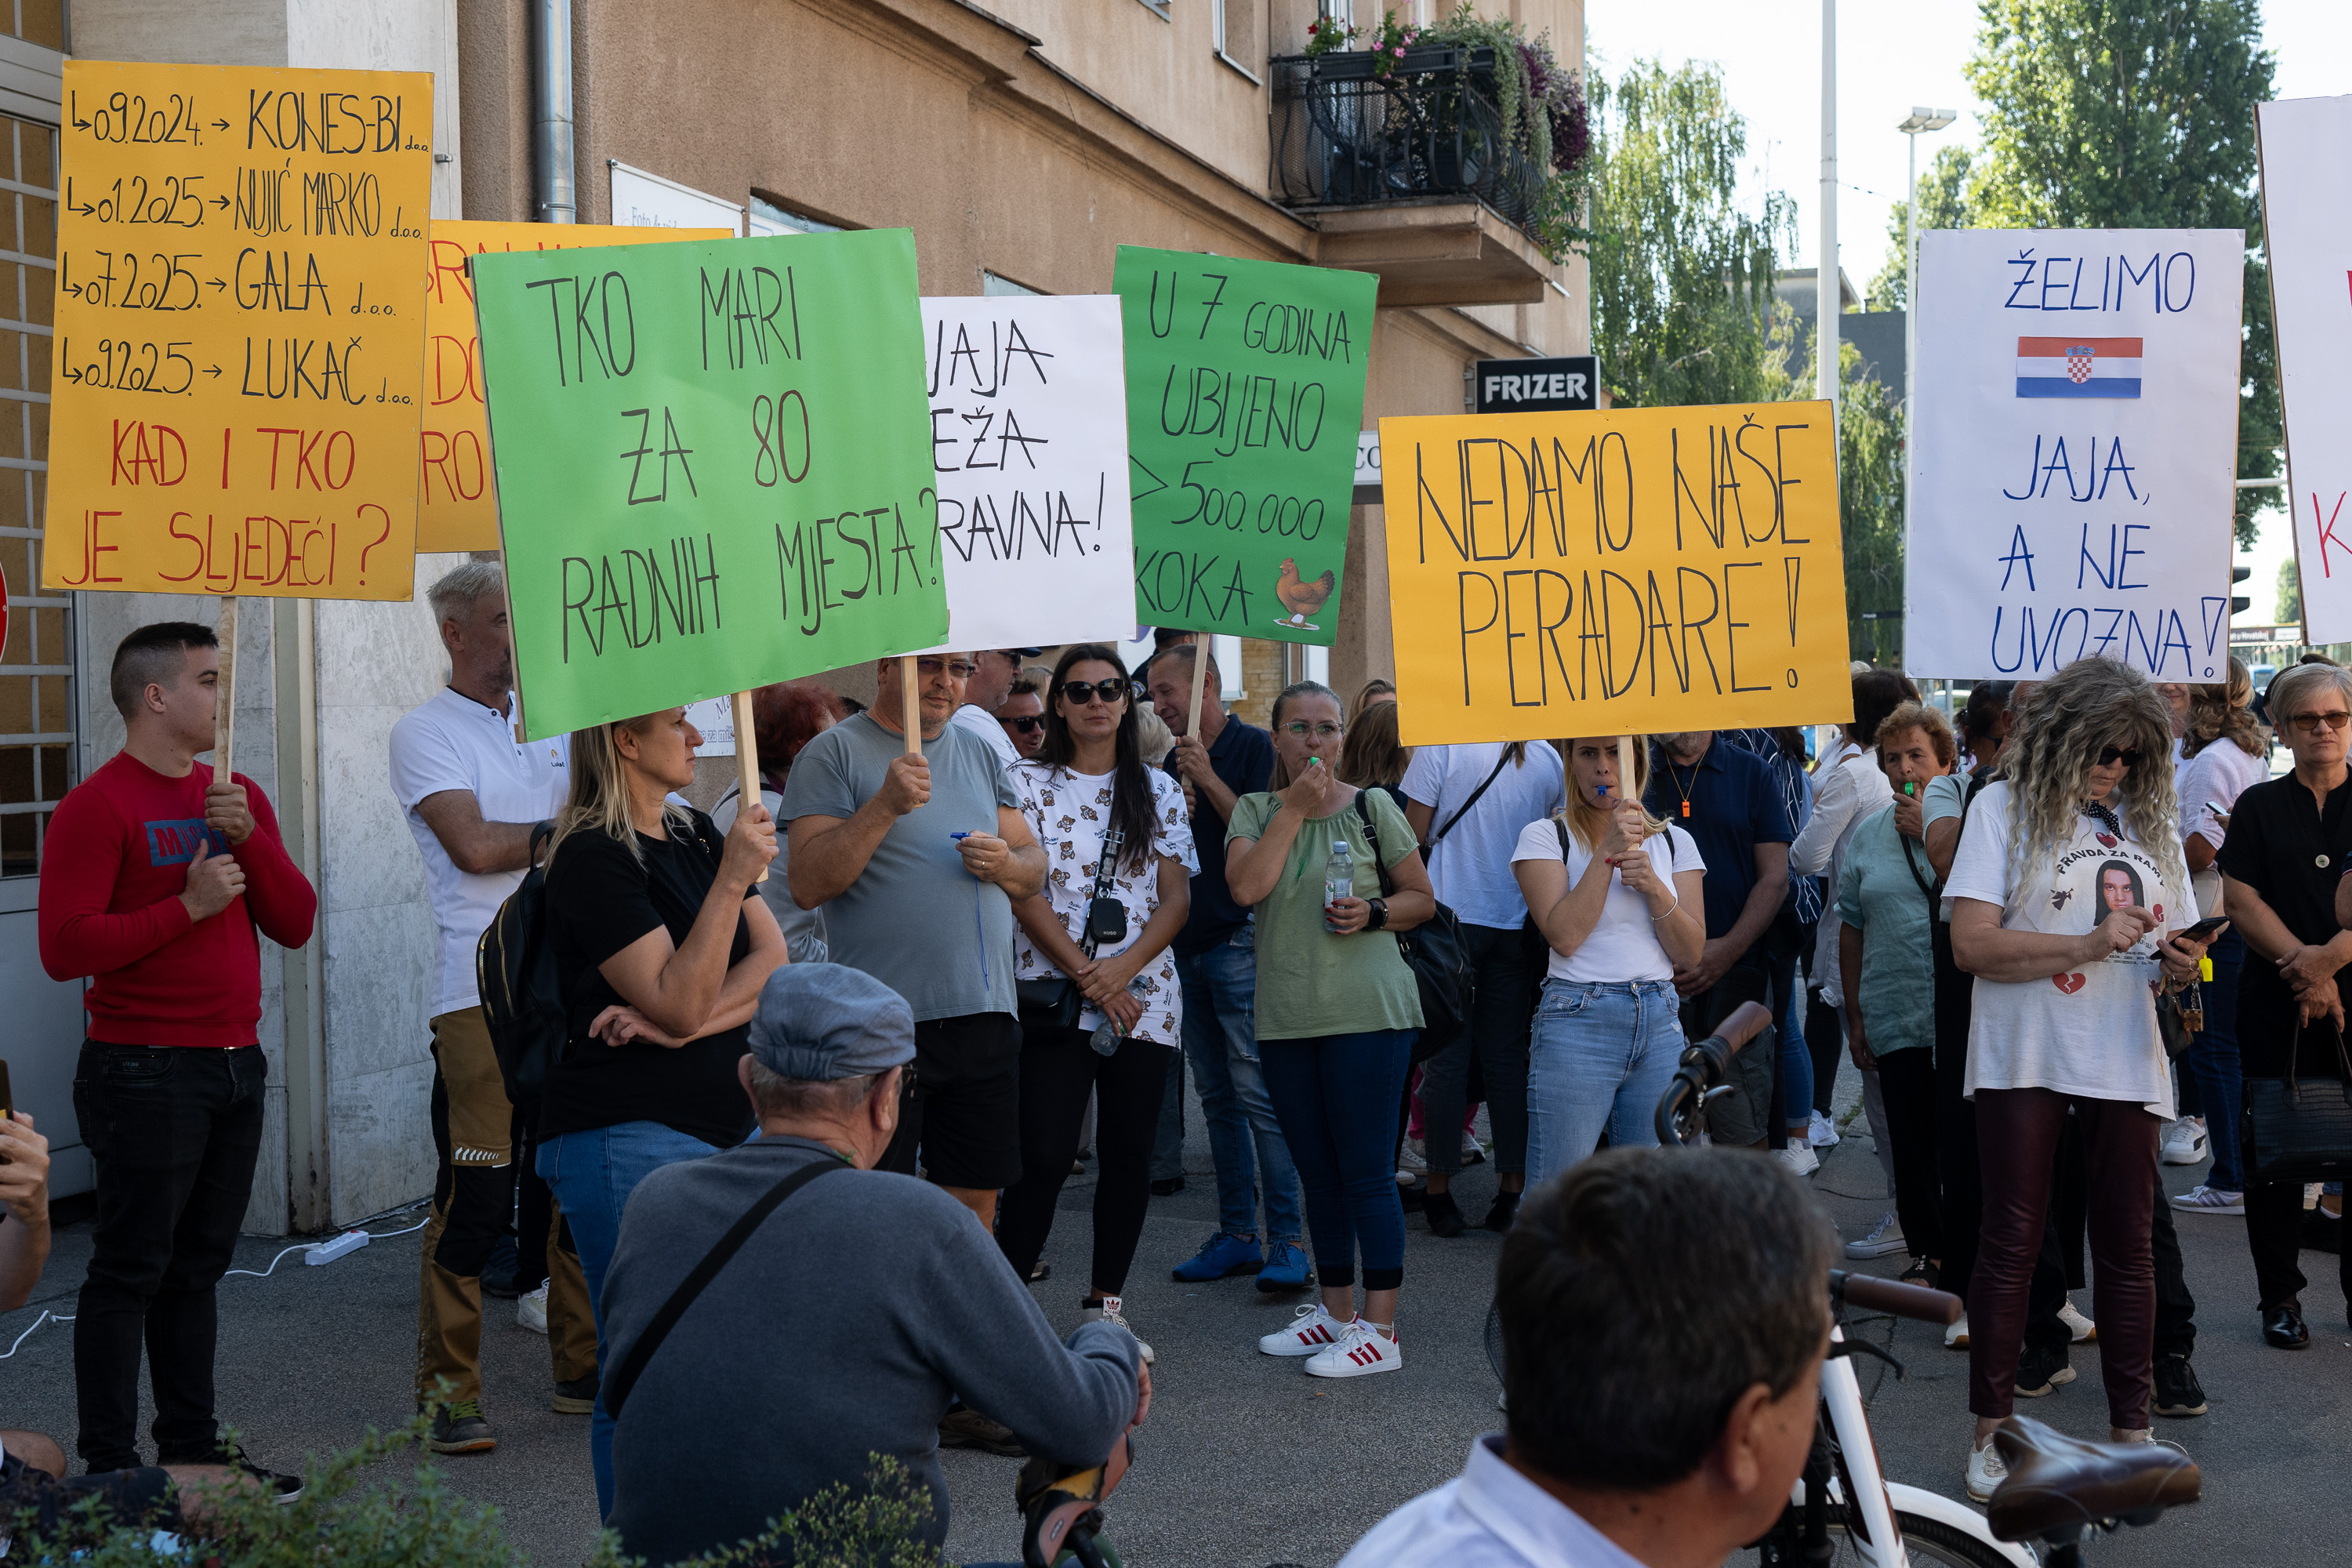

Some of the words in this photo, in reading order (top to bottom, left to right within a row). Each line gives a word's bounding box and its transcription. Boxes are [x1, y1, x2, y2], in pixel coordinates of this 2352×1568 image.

[95, 93, 202, 146] 09.2024.
[248, 89, 401, 154] KONES-BI
[98, 176, 204, 227] 01.2025.
[234, 158, 292, 238] NUJIĆ
[303, 172, 380, 237] MARKO
[390, 206, 423, 240] d.o.o.
[86, 250, 202, 311] 07.2025.
[236, 248, 331, 316] GALA
[1150, 270, 1176, 338] U
[1200, 274, 1228, 339] 7
[1244, 302, 1351, 364] GODINA
[2005, 248, 2194, 314] ŽELIMO
[525, 271, 634, 387] TKO
[701, 266, 801, 370] MARI
[928, 319, 1054, 397] JAJA
[85, 339, 193, 396] 09.2025.
[241, 336, 366, 405] LUKAČ
[376, 377, 413, 406] d.o.o.
[1485, 372, 1588, 404] FRIZER
[620, 406, 697, 505] ZA
[753, 390, 810, 487] 80
[931, 405, 1048, 471] EŽA
[1162, 365, 1324, 457] UBIJENO
[112, 419, 187, 486] KAD
[223, 428, 230, 489] I
[257, 428, 354, 492] TKO
[422, 430, 495, 506] RO
[1417, 432, 1633, 564] NEDAMO
[1672, 412, 1810, 550] NAŠE
[2003, 434, 2149, 505] JAJA,
[63, 510, 122, 585] JE
[562, 533, 720, 663] RADNIH
[775, 487, 938, 636] MJESTA?
[1998, 524, 2035, 591] A
[2078, 523, 2150, 590] NE
[1135, 546, 1254, 626] KOKA
[2056, 849, 2107, 875] PRAVDA
[2109, 850, 2129, 858] ZA
